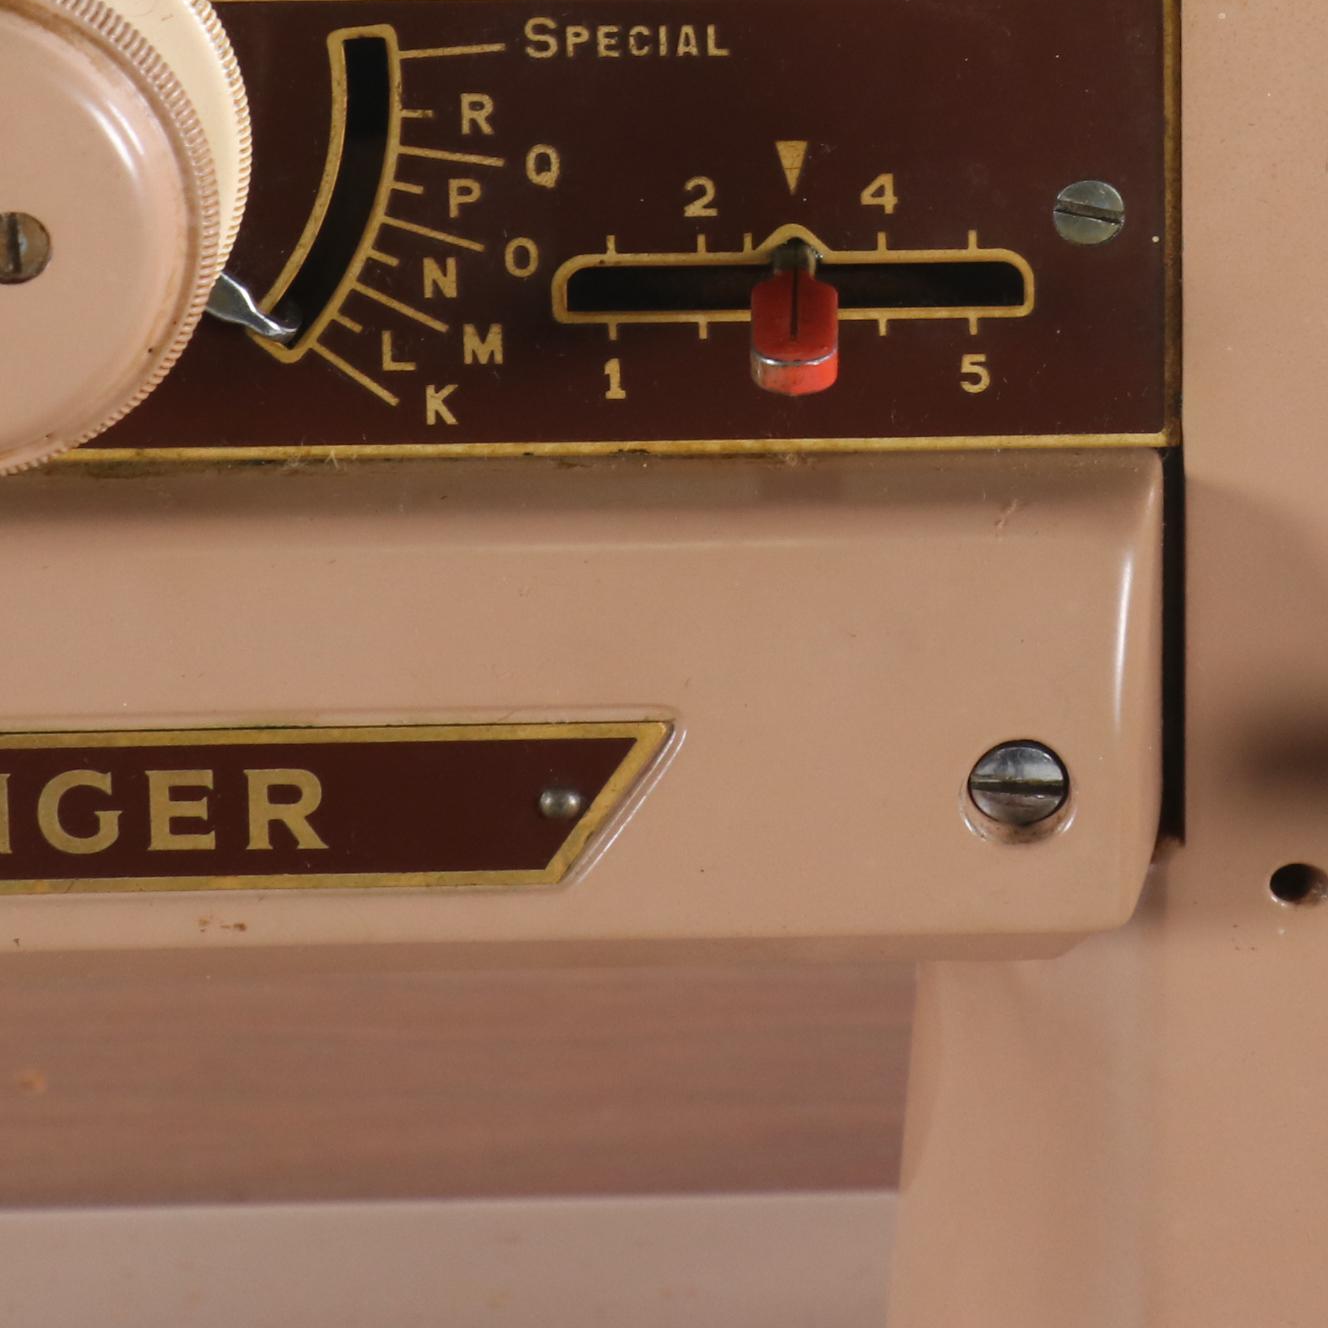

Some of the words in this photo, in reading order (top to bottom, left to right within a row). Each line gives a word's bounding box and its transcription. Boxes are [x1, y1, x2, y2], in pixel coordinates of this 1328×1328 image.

[525, 17, 728, 58] SPECIAL
[461, 93, 493, 134] R
[526, 144, 559, 188] Q
[449, 179, 481, 218] P
[685, 177, 717, 217] 2
[861, 174, 897, 214] 4
[505, 237, 538, 277] O
[424, 258, 457, 298] N
[382, 334, 416, 371] L
[464, 325, 503, 364] M
[605, 359, 626, 399] 1
[961, 354, 990, 393] 5
[426, 385, 457, 425] K
[0, 768, 328, 854] GER
